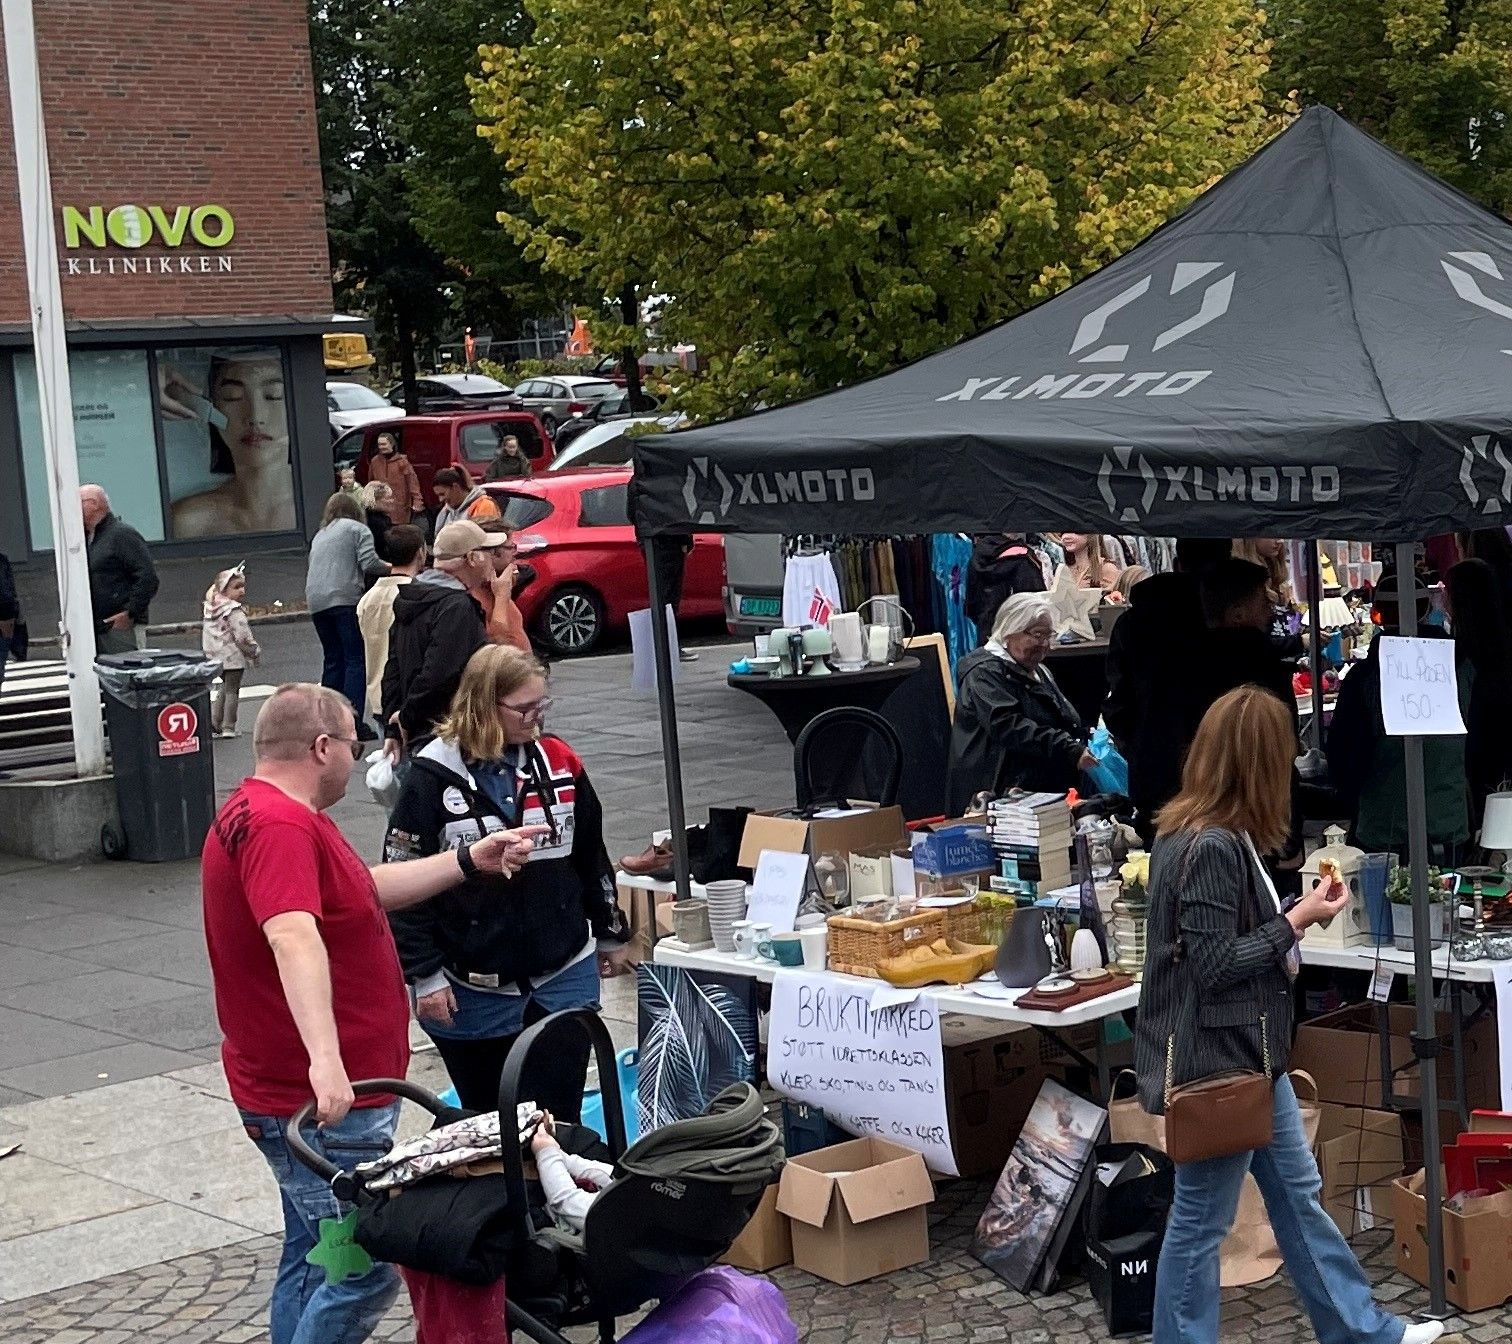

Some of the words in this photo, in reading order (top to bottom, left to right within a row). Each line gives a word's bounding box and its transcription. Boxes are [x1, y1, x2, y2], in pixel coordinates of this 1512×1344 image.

[62, 204, 235, 249] NOVO
[67, 256, 232, 275] KLINIKKEN
[936, 370, 1213, 402] XLMOTO
[737, 467, 876, 505] XLMOTO
[1164, 465, 1341, 503] XLMOTO
[799, 985, 934, 1039] BRUKTMARKED
